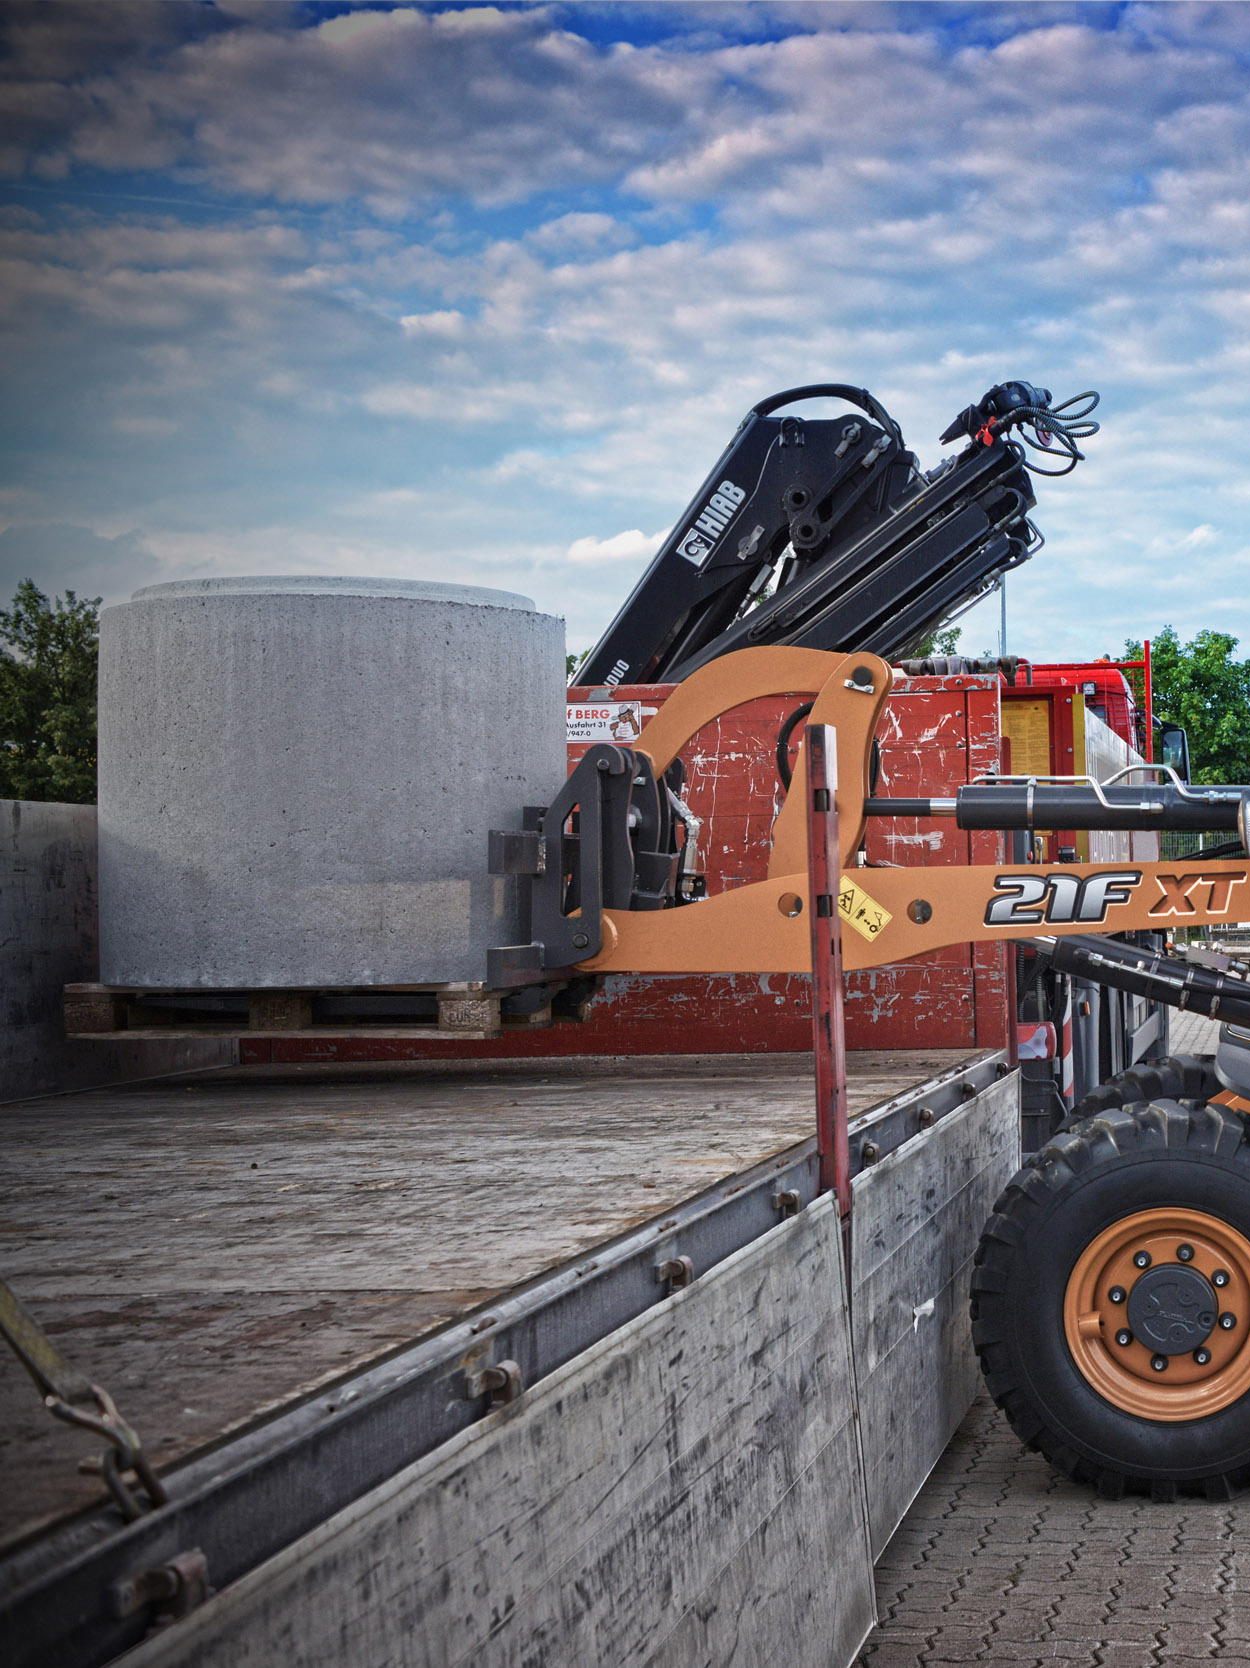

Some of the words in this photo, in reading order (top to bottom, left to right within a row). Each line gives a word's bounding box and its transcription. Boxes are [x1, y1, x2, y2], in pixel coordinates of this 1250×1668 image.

[694, 480, 746, 539] HIAB
[575, 709, 610, 719] BERG
[983, 870, 1143, 927] 21F
[1148, 871, 1247, 916] XT
